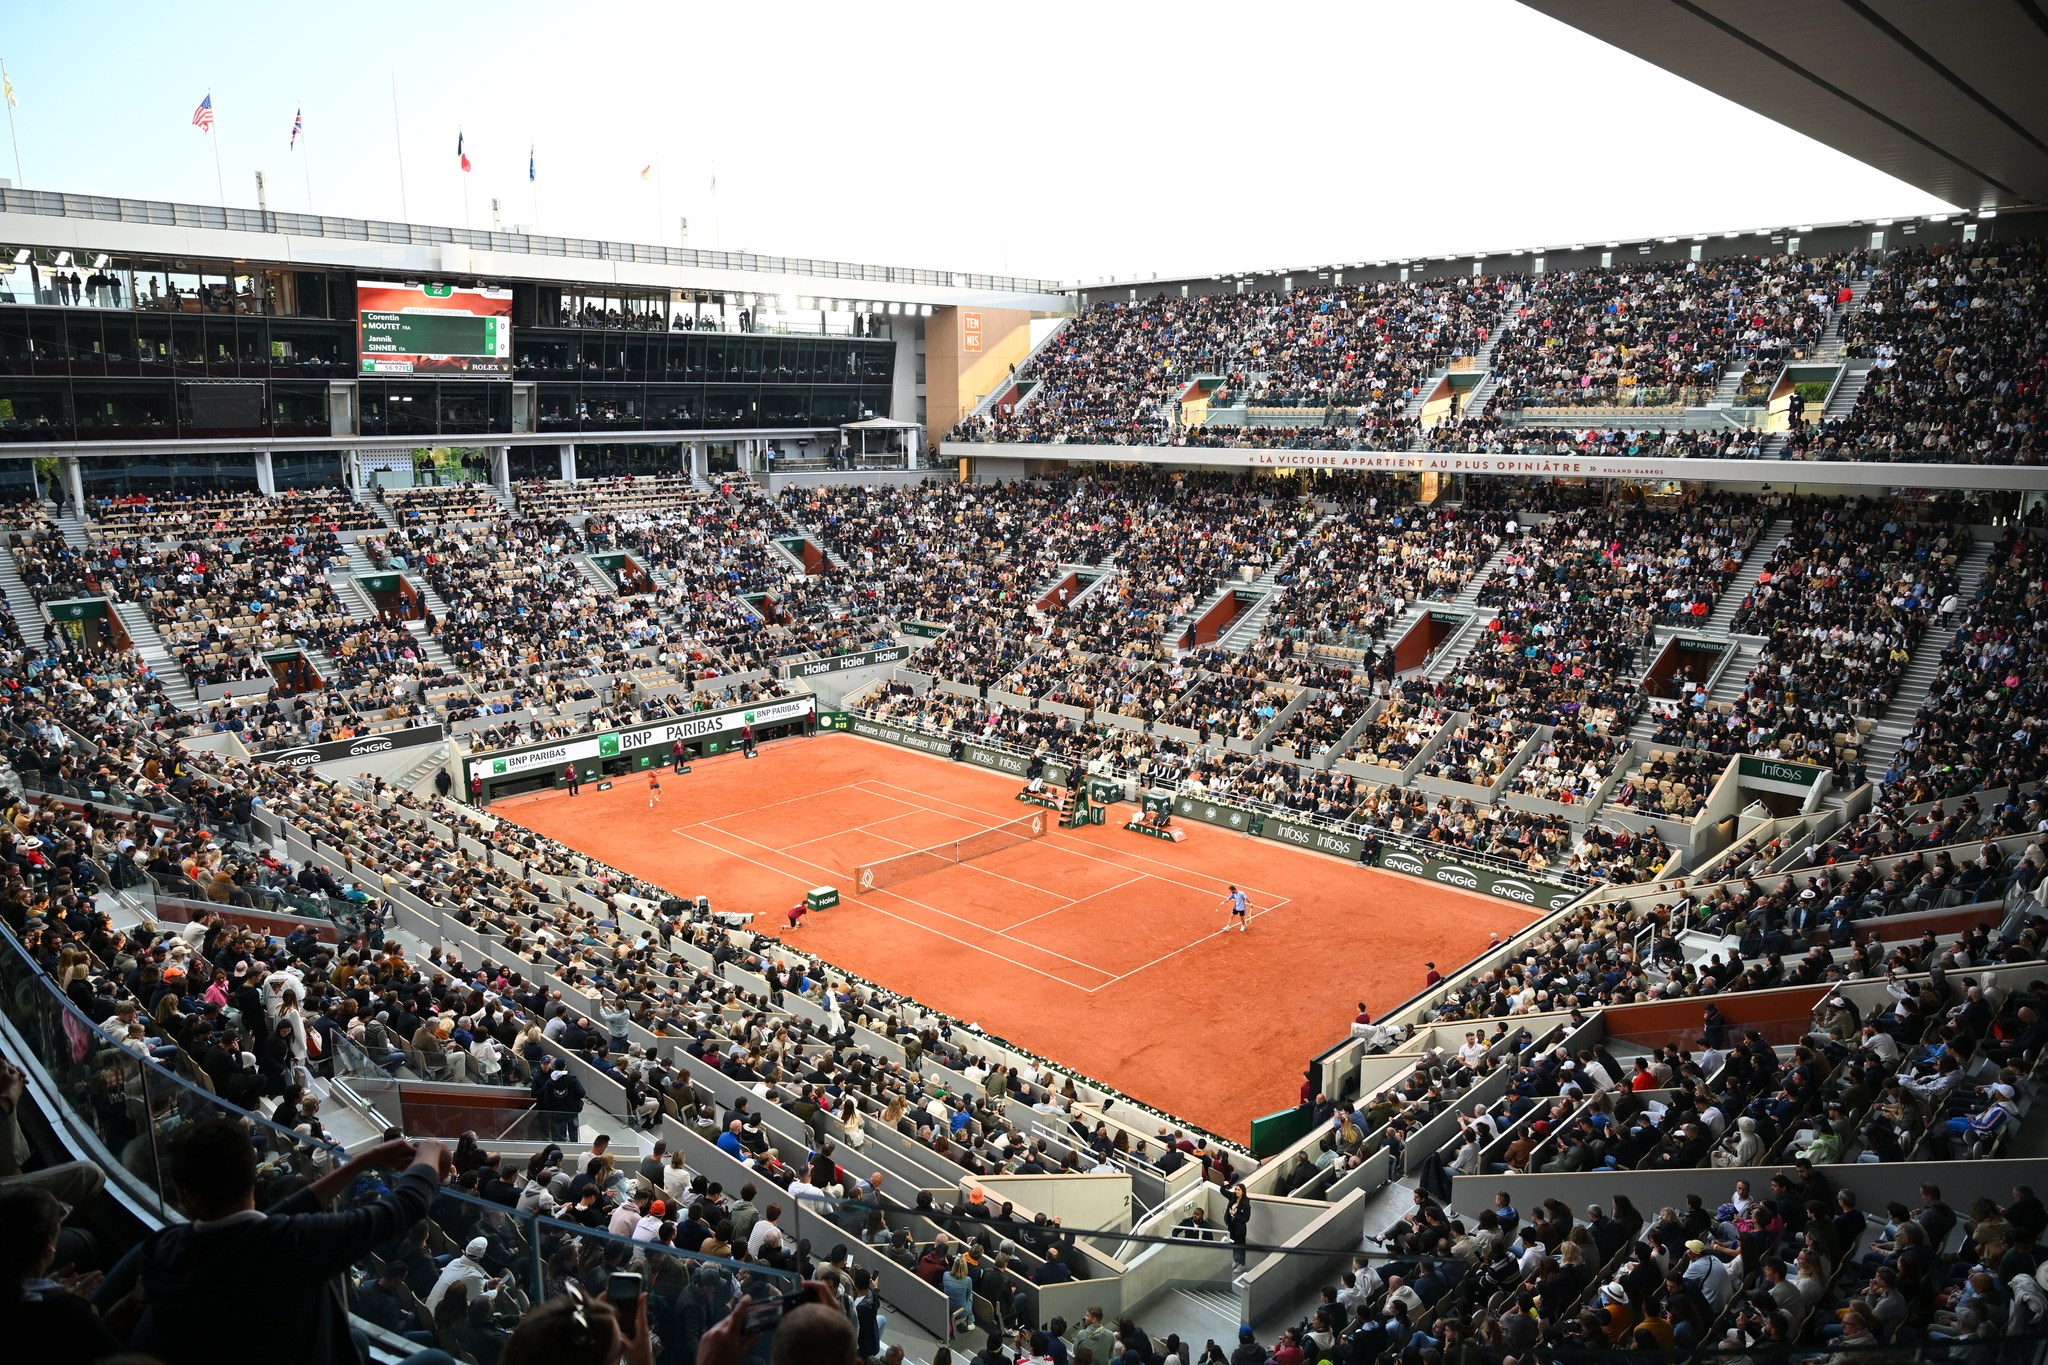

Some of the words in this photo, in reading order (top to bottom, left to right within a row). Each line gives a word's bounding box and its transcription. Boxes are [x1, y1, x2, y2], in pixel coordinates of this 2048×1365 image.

[368, 313, 400, 321] Corentin
[966, 318, 979, 329] TEN
[967, 336, 979, 346] NIS
[1260, 455, 1273, 463] LA
[1279, 456, 1336, 464] VICTOIRE
[1343, 457, 1423, 467] APPARTIENT
[1431, 460, 1447, 468] AU
[1456, 461, 1489, 469] PLUS
[1497, 461, 1581, 472] OPINIÂTRE
[904, 625, 919, 634] Haier
[804, 662, 830, 675] Haier
[840, 656, 866, 669] Haier
[875, 651, 898, 663] Haier
[756, 709, 771, 718] BNP
[772, 703, 800, 715] PARIBAS
[622, 732, 652, 749] BNP
[666, 717, 723, 740] PARIBAS
[854, 722, 878, 736] Emirates
[903, 734, 929, 748] Emirates
[509, 756, 527, 766] BNP
[530, 748, 566, 762] PARIBAS
[972, 749, 994, 764] Infosys
[999, 756, 1022, 772] Infosys
[1761, 762, 1802, 781] Infosys
[1278, 824, 1309, 843] Infosys
[1317, 833, 1350, 854] Infosys
[820, 896, 836, 906] Haier
[1124, 1196, 1129, 1207] 2
